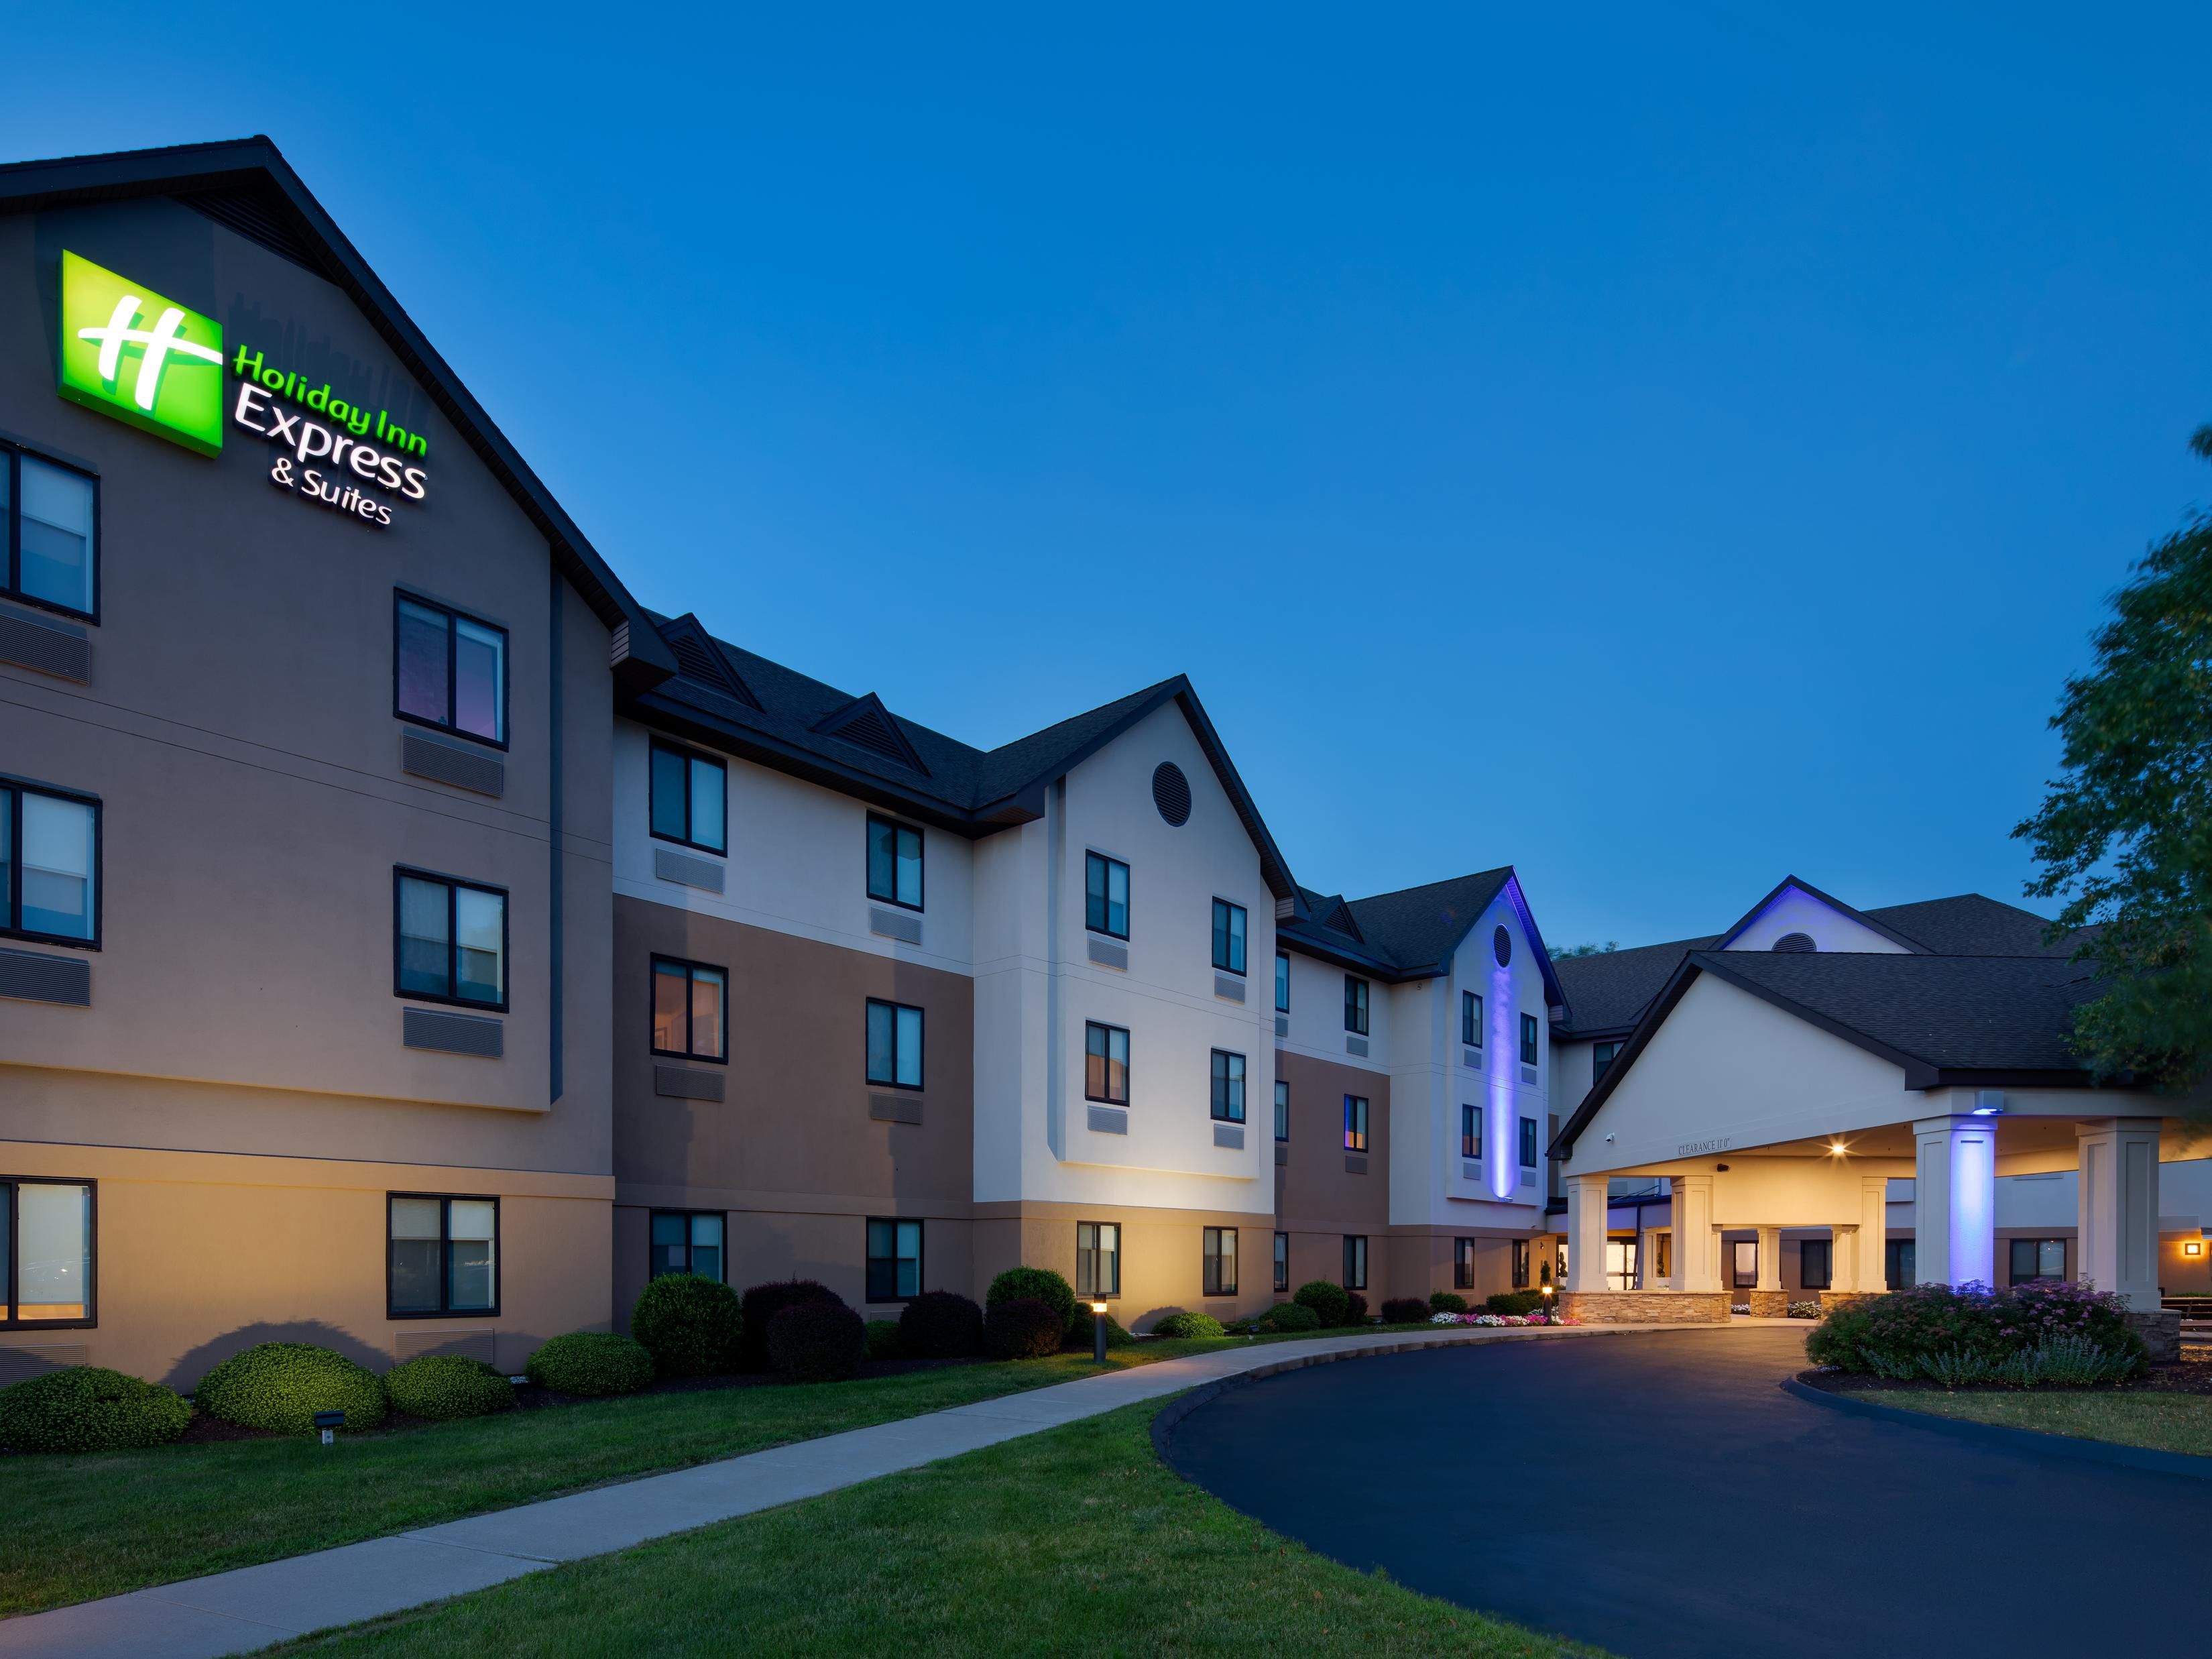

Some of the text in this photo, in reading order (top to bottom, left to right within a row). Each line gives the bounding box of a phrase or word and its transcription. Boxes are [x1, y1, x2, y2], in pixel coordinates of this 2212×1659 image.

[233, 344, 427, 456] Holiday Inn
[235, 382, 426, 499] Express
[271, 457, 392, 525] & Suites
[1678, 1140, 1715, 1155] CLEARANCE
